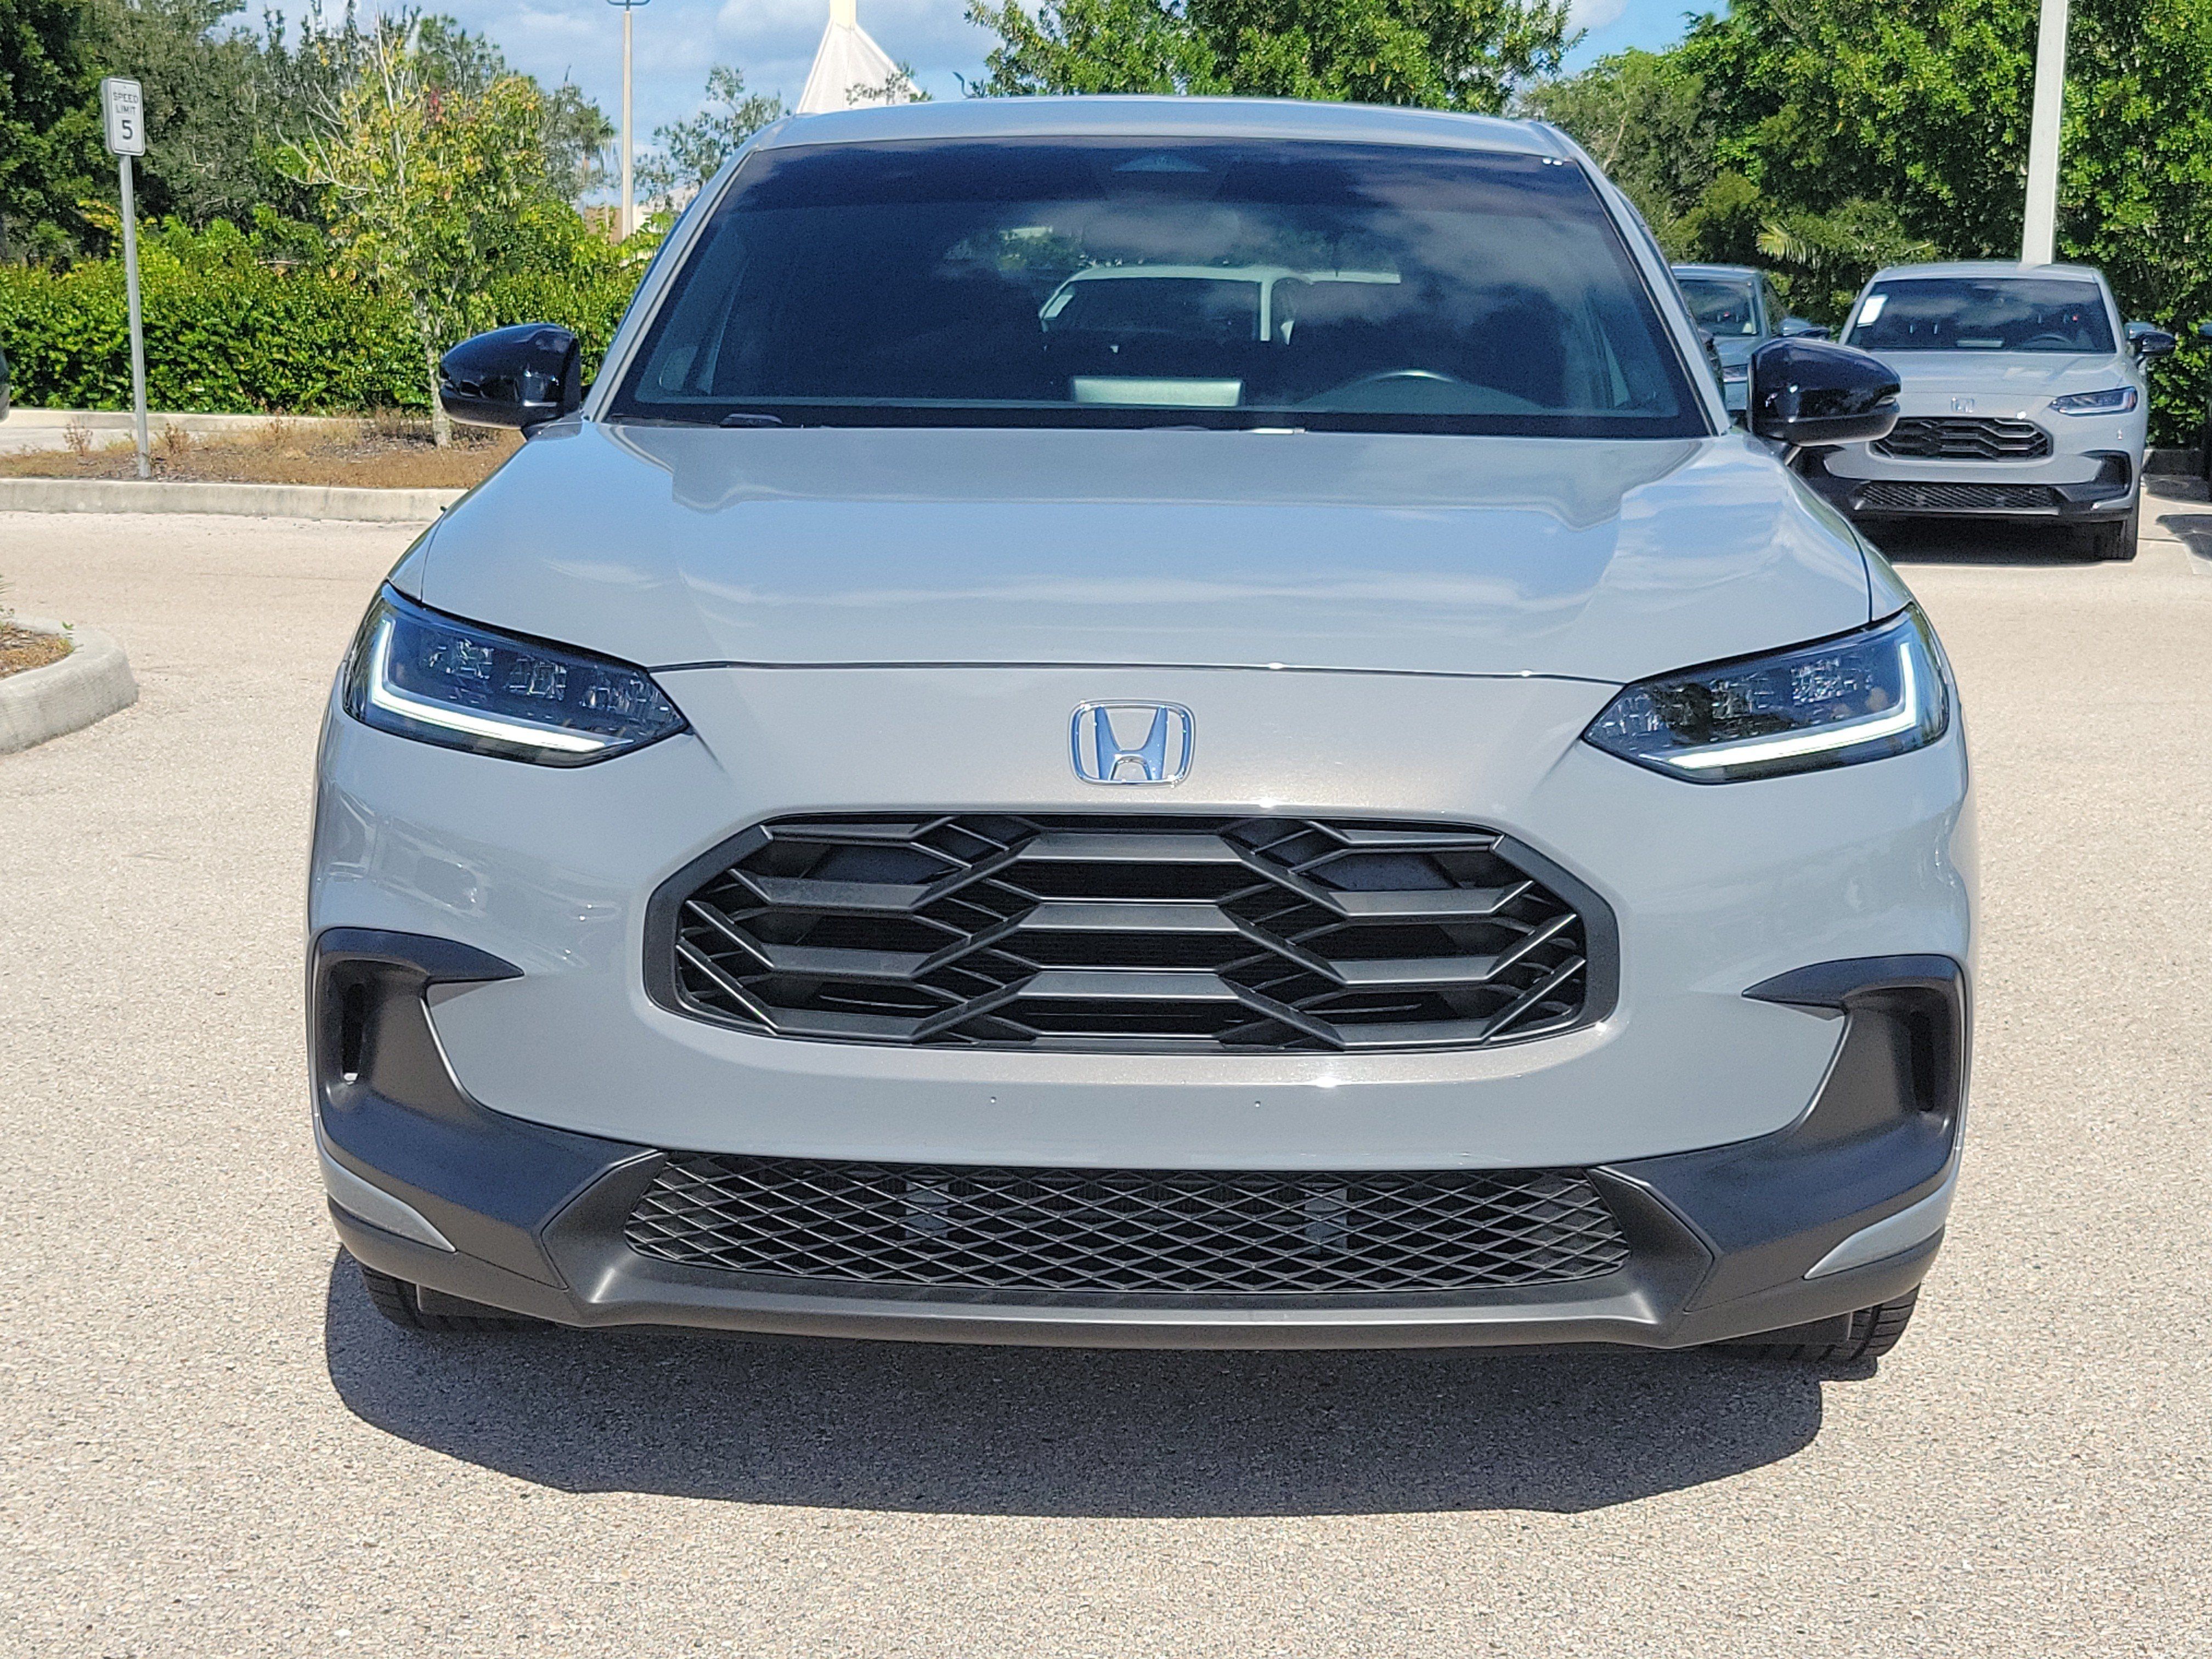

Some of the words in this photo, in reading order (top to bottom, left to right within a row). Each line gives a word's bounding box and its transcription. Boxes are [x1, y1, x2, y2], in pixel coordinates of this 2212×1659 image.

[113, 92, 138, 103] SPEED
[116, 105, 136, 115] LIMIT
[122, 120, 133, 139] 5
